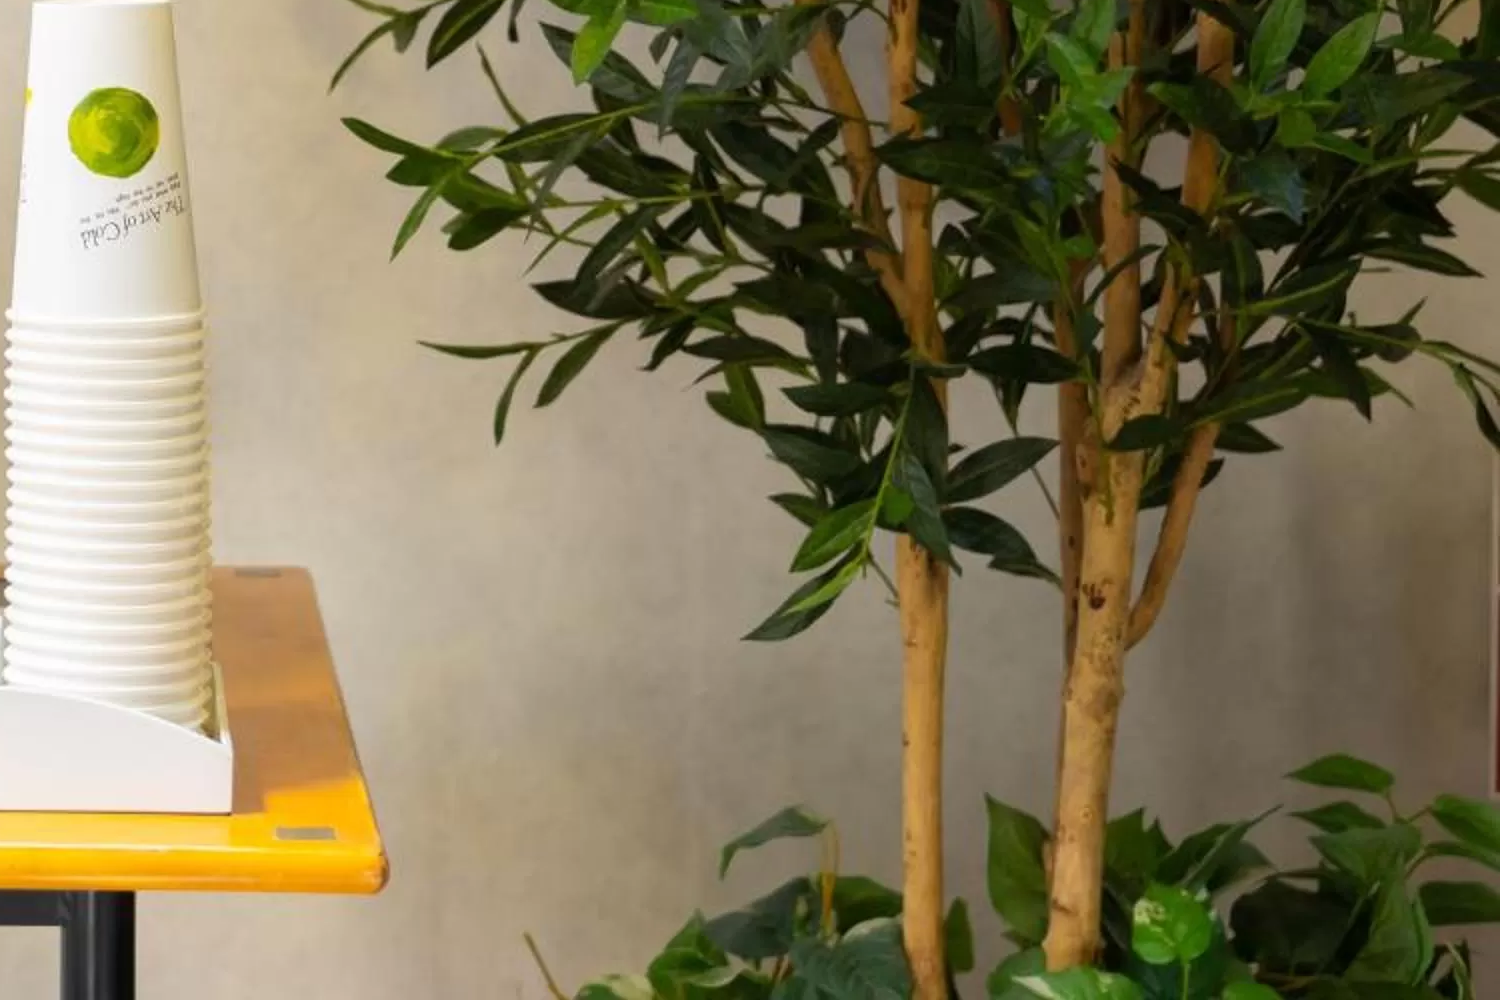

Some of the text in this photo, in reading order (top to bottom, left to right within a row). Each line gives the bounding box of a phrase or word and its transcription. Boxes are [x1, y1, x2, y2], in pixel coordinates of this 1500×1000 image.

[139, 208, 161, 224] Art
[165, 195, 184, 216] The
[80, 221, 121, 249] Cold
[122, 214, 137, 238] of
